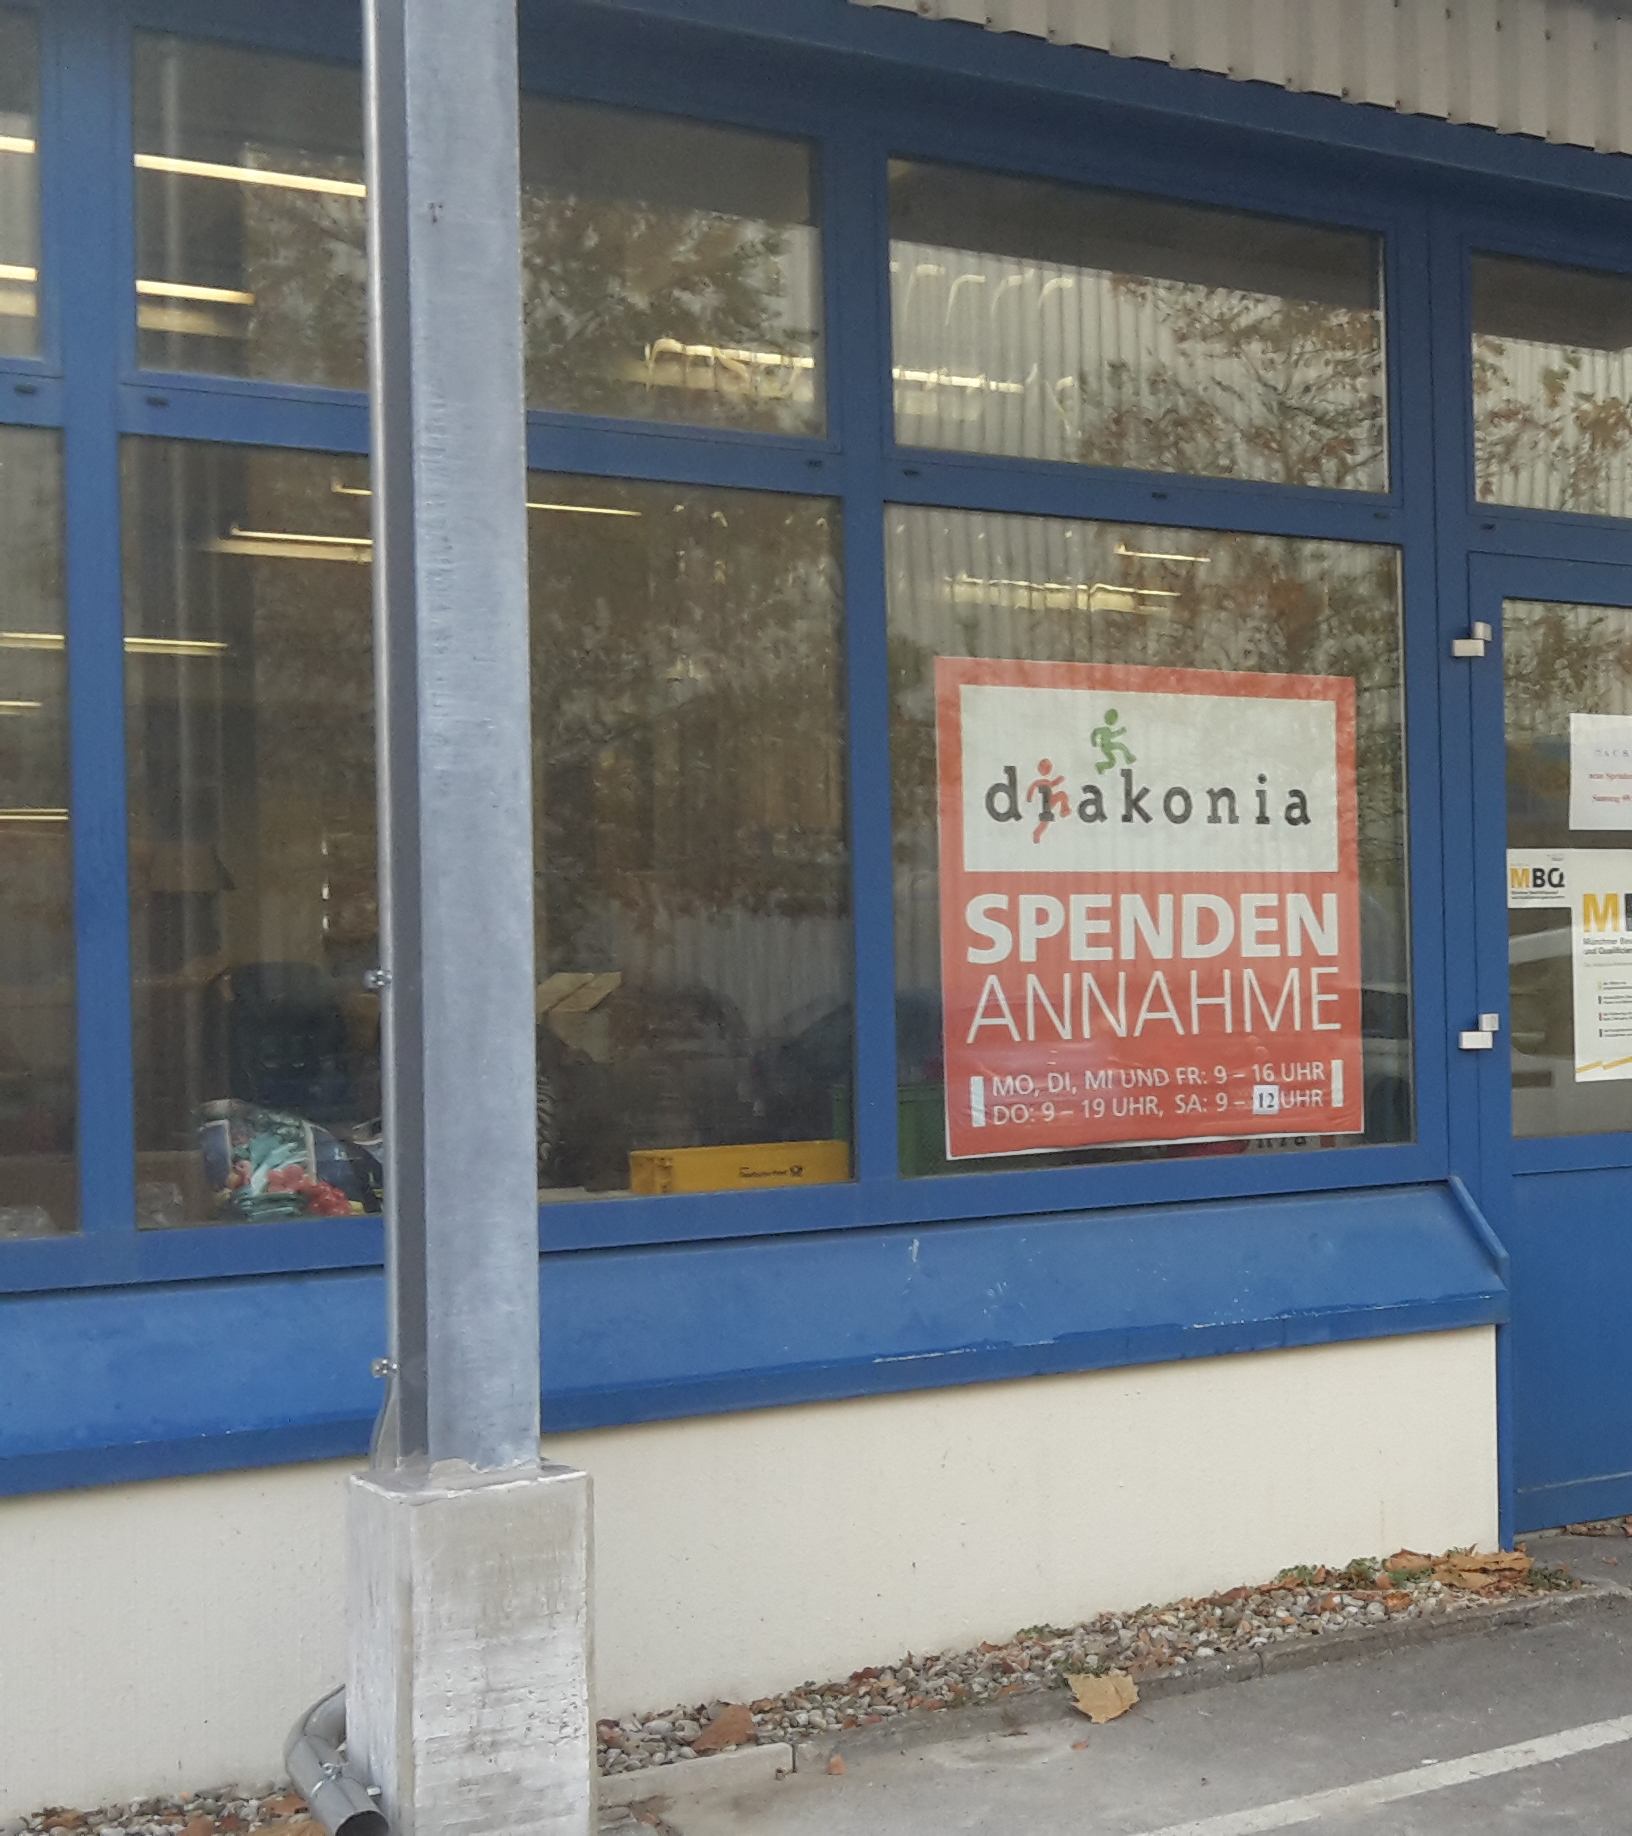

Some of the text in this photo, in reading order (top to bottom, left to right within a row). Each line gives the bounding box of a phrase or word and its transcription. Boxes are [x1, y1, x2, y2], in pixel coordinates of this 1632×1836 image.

[984, 763, 1312, 827] diakonia
[1511, 867, 1566, 888] MBQ
[964, 893, 1340, 964] SPENDEN
[966, 967, 1341, 1044] ANNAHME
[992, 1075, 1039, 1098] MO,
[1047, 1073, 1077, 1095] DI,
[1085, 1070, 1112, 1091] MI
[1121, 1067, 1169, 1089] UND
[1176, 1065, 1208, 1087] FR:
[1214, 1065, 1227, 1085] 9
[1252, 1063, 1273, 1083] 16
[1281, 1061, 1325, 1082] UHR
[992, 1103, 1035, 1126] DO:
[1042, 1101, 1055, 1122] 9
[1083, 1099, 1105, 1119] 19
[1111, 1095, 1164, 1118] UHR,
[1174, 1092, 1208, 1114] SA:
[1215, 1092, 1228, 1112] 9
[1256, 1091, 1275, 1110] 12
[1279, 1089, 1324, 1110] UHR
